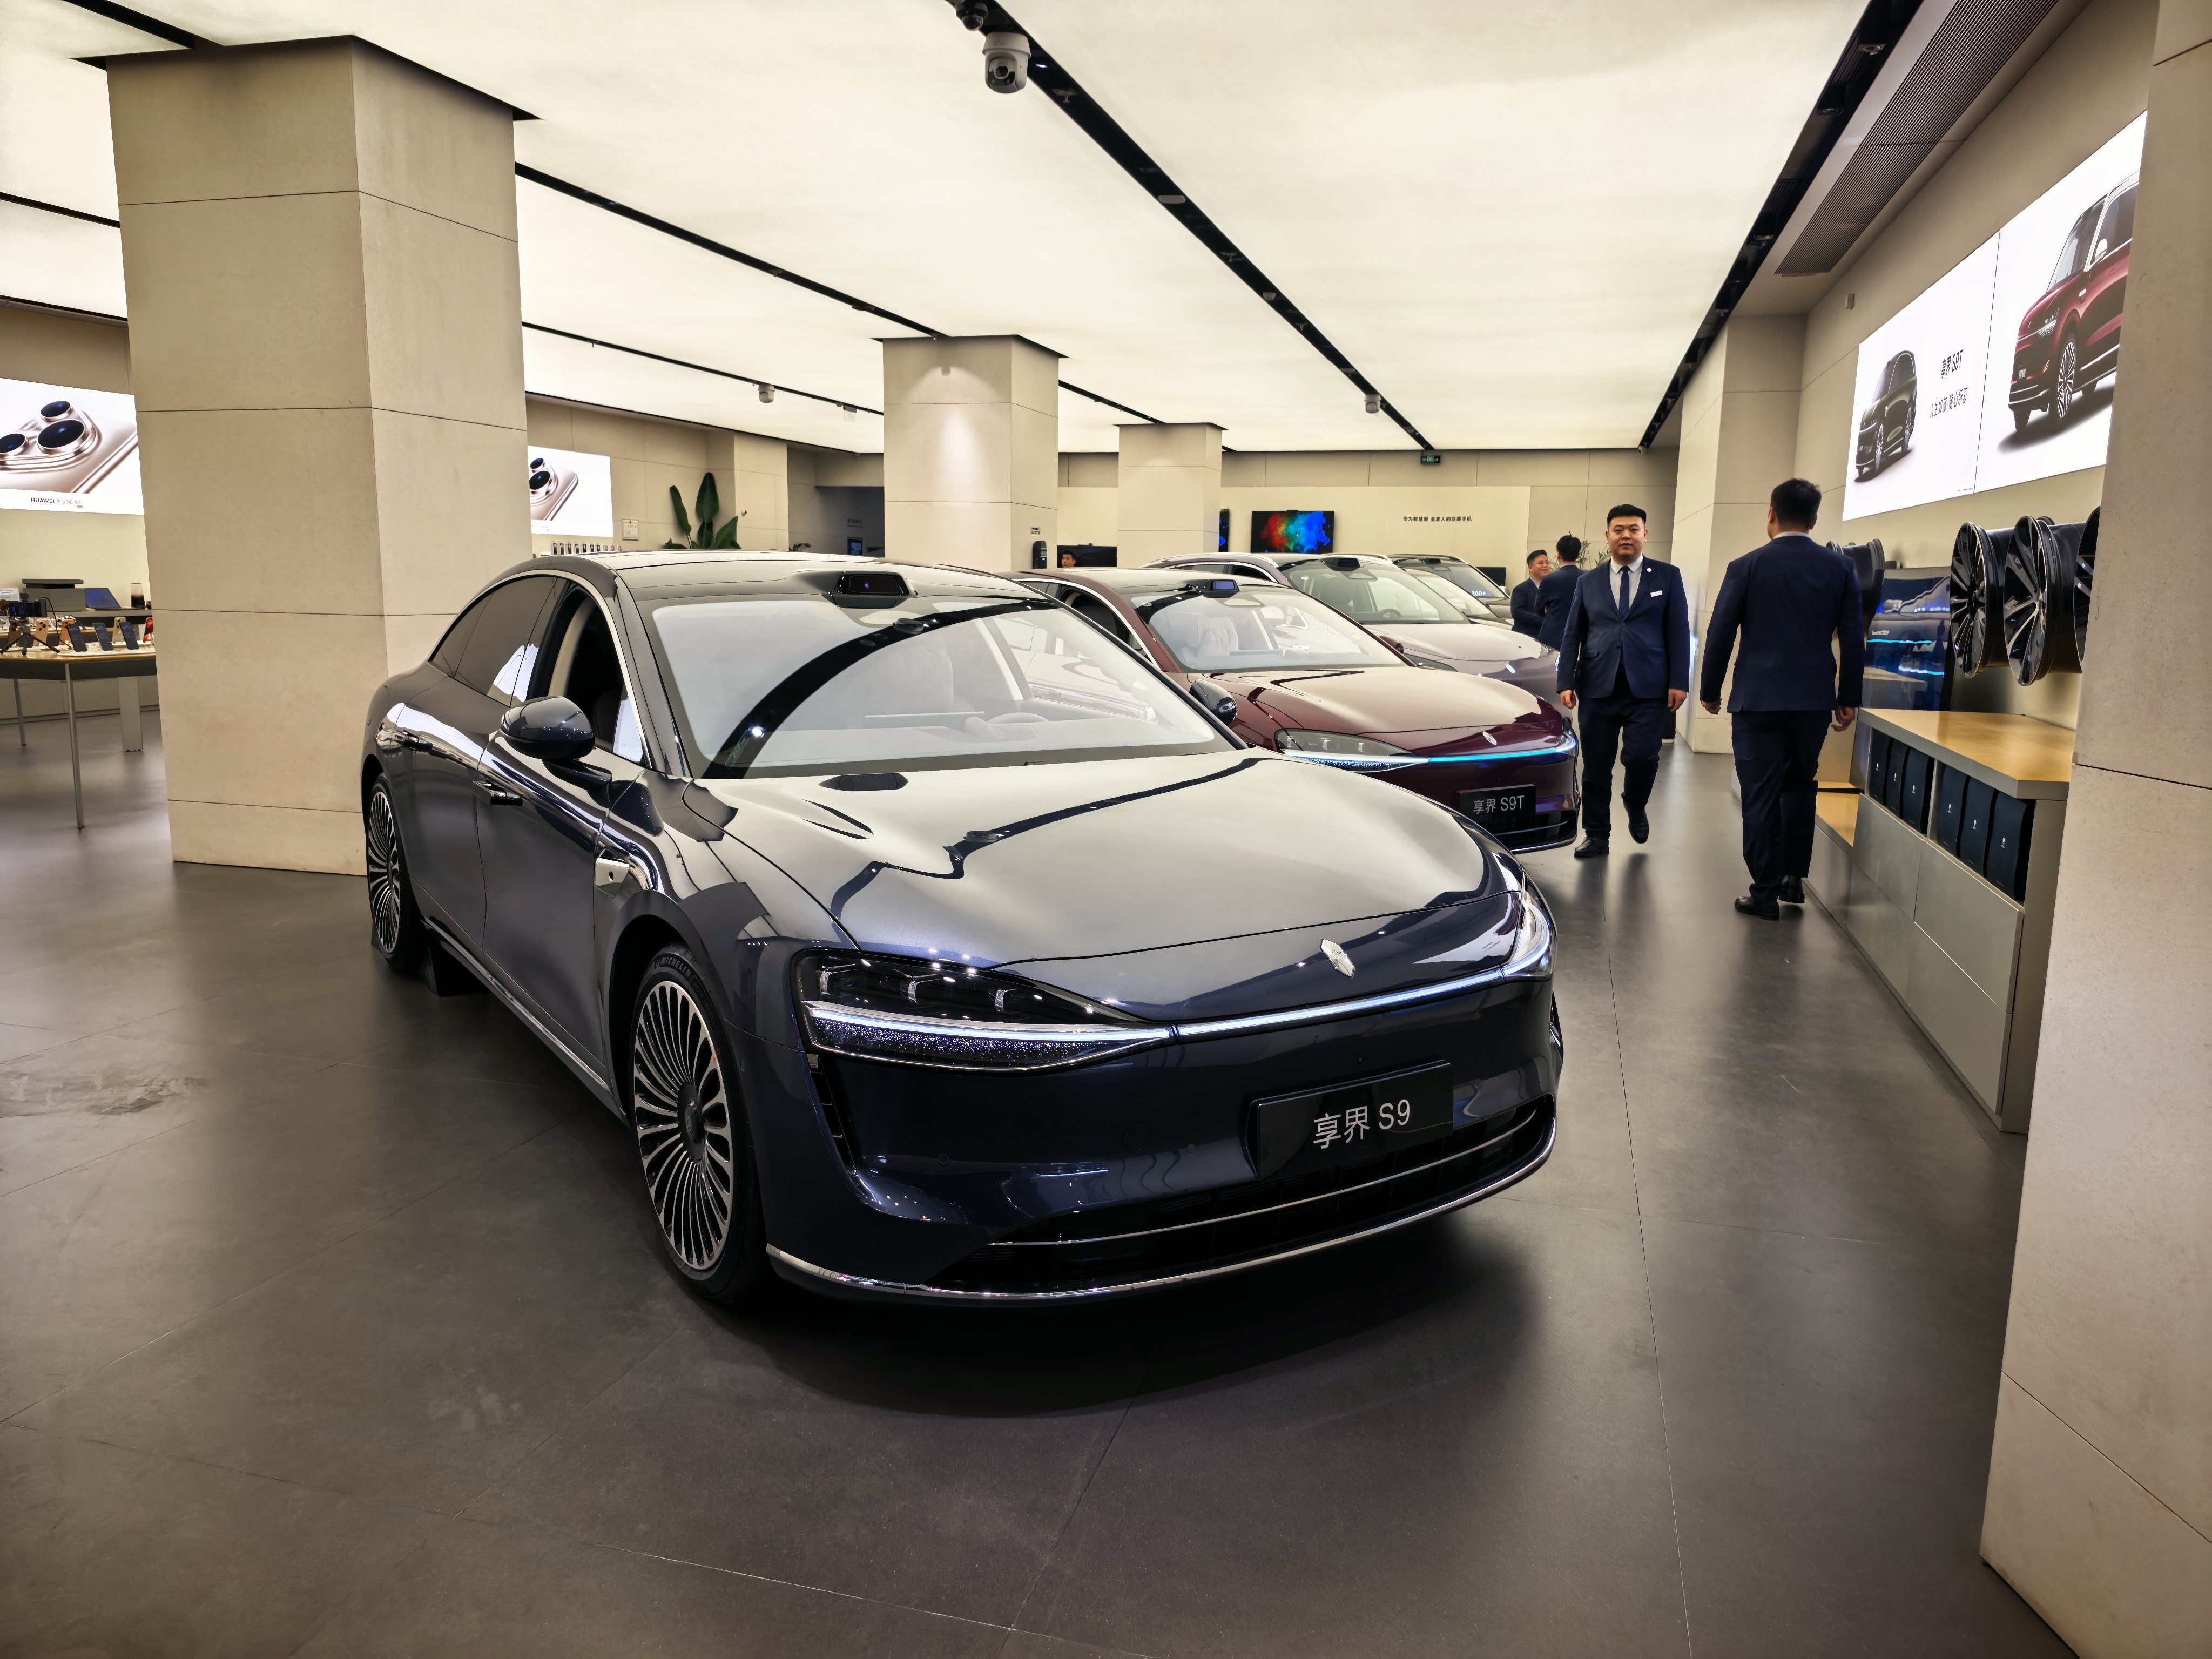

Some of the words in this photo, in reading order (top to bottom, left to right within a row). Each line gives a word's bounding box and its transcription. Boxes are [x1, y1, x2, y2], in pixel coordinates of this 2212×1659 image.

[1941, 356, 1951, 379] 享界
[1952, 349, 1963, 372] S9T
[1473, 798, 1496, 814] 享界
[1501, 795, 1525, 811] S9T
[660, 956, 691, 977] MICHELIN
[1313, 1105, 1370, 1149] 享界
[1379, 1099, 1410, 1130] S9
